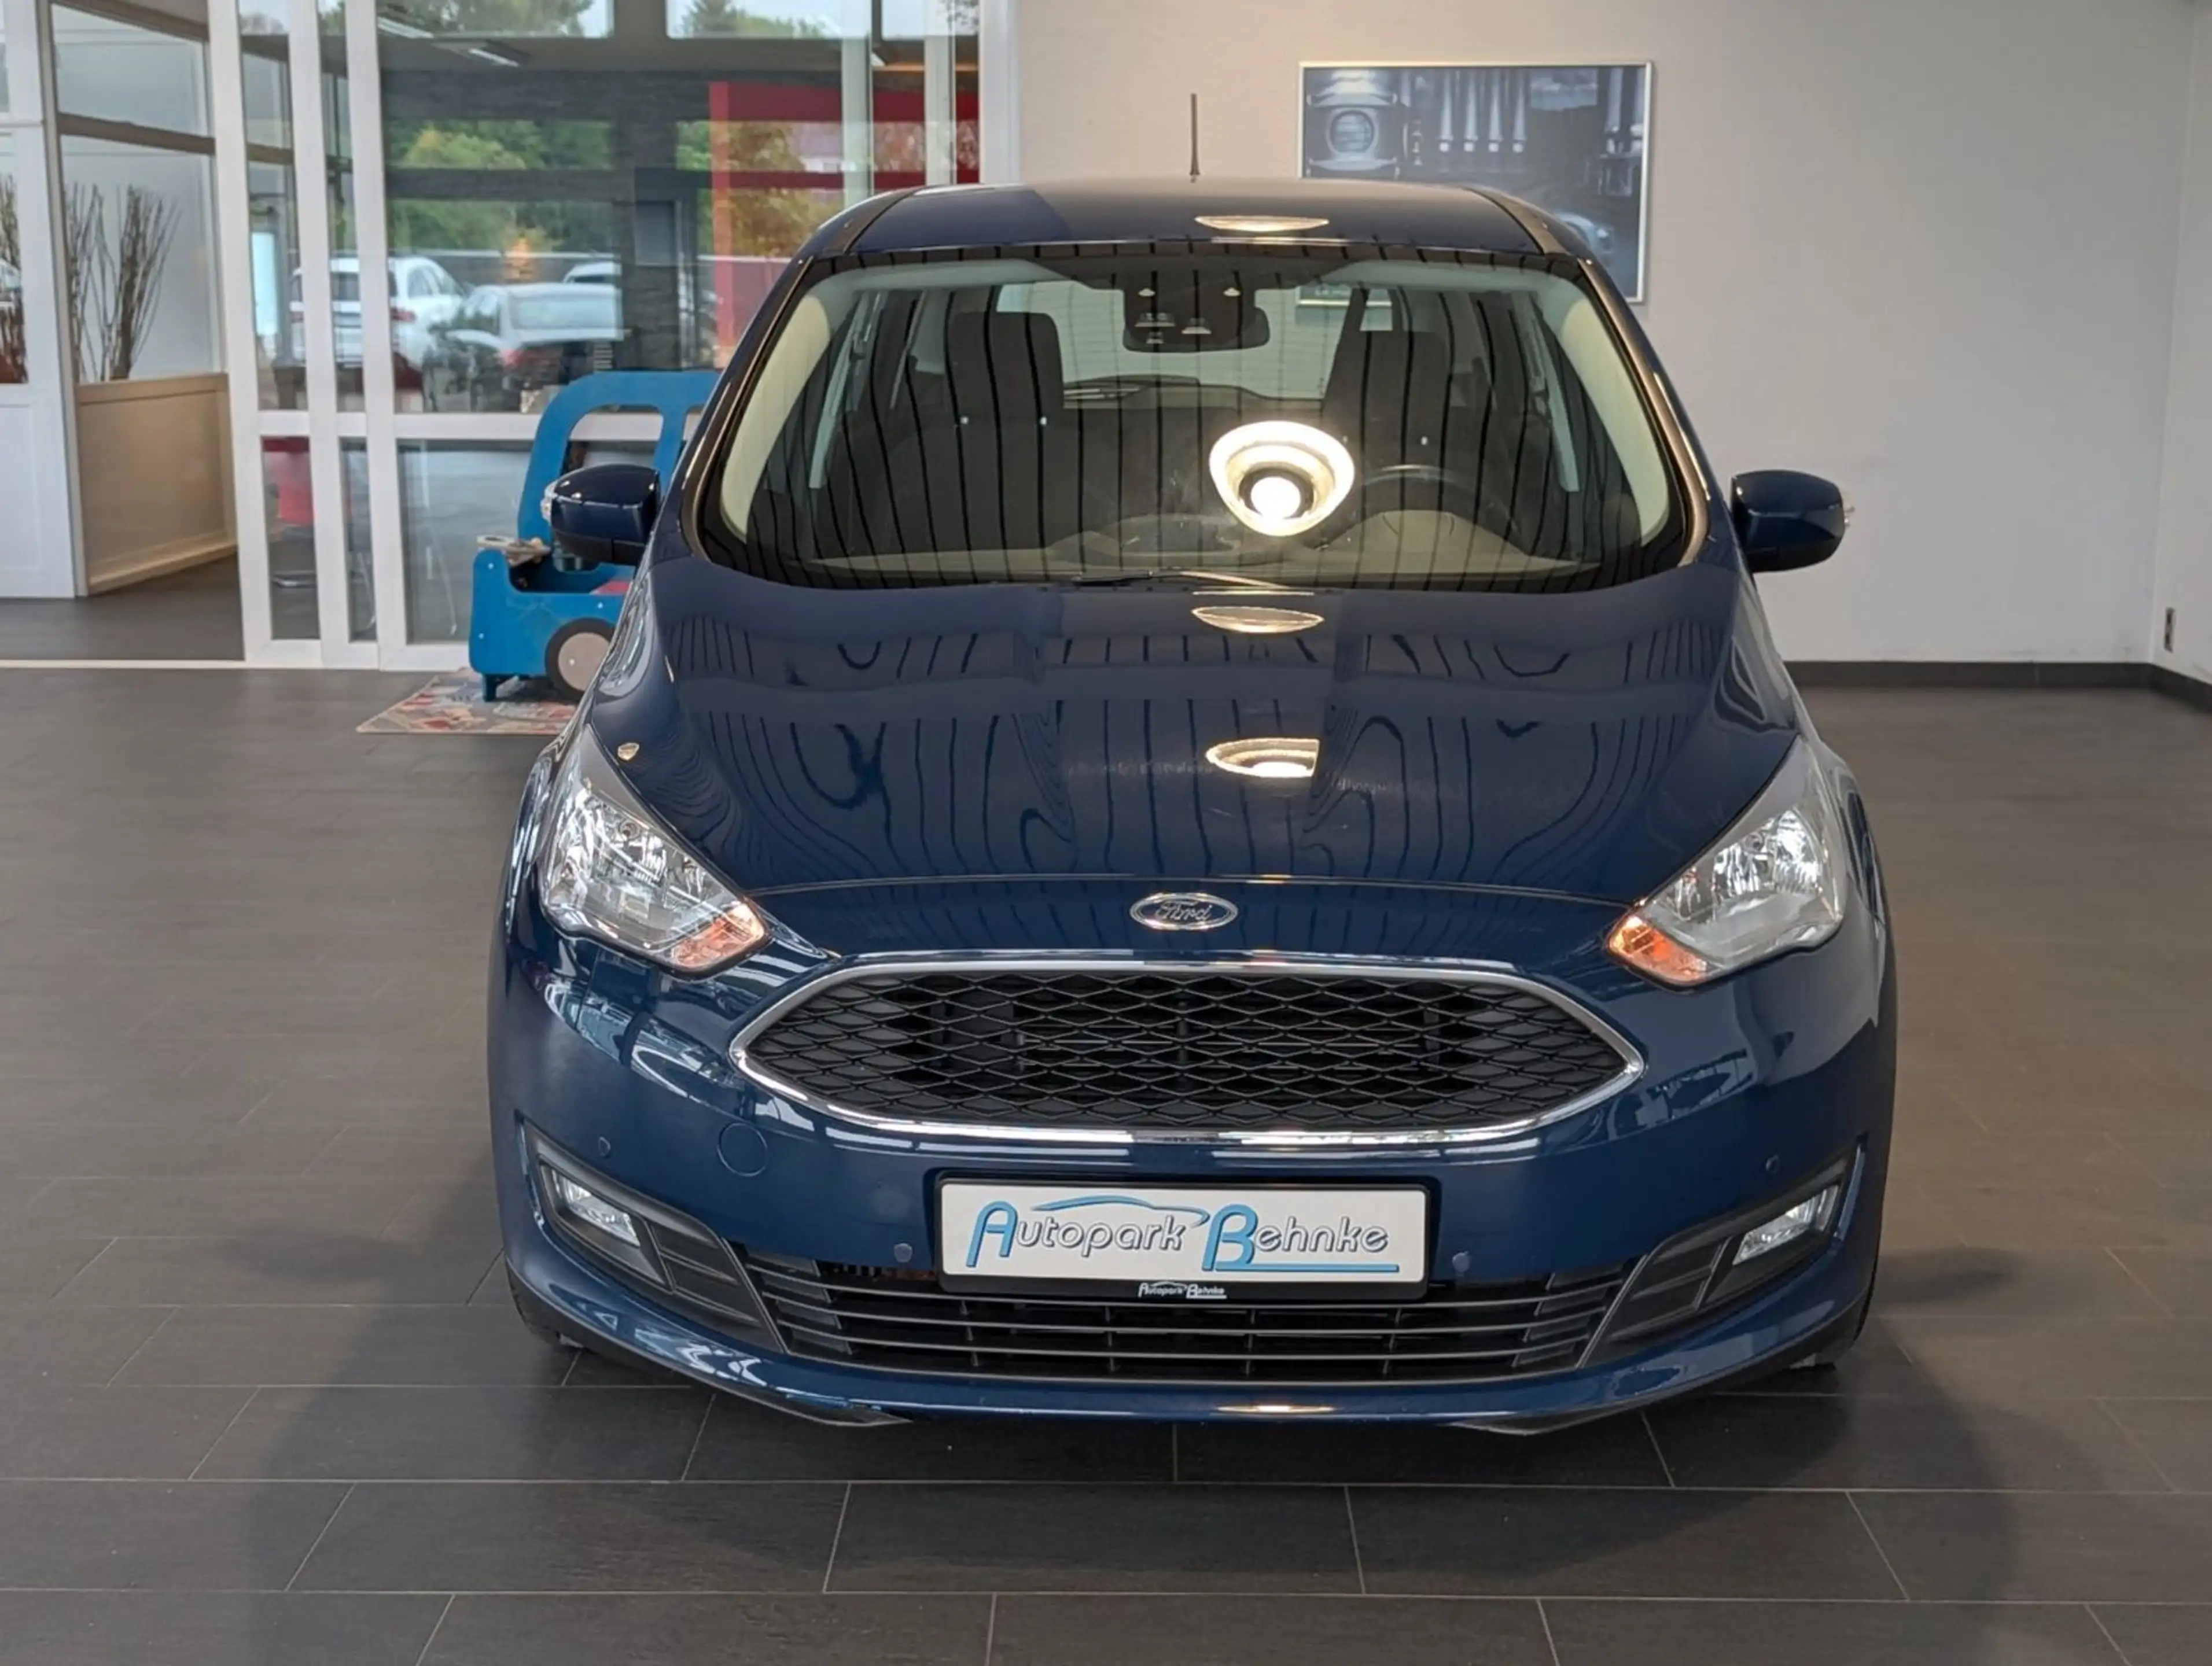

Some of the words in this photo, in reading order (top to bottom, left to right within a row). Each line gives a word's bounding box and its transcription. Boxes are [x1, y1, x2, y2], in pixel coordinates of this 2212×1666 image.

[1154, 900, 1212, 921] Ford
[966, 1200, 1186, 1268] Autopark
[1202, 1203, 1389, 1271] Behnke
